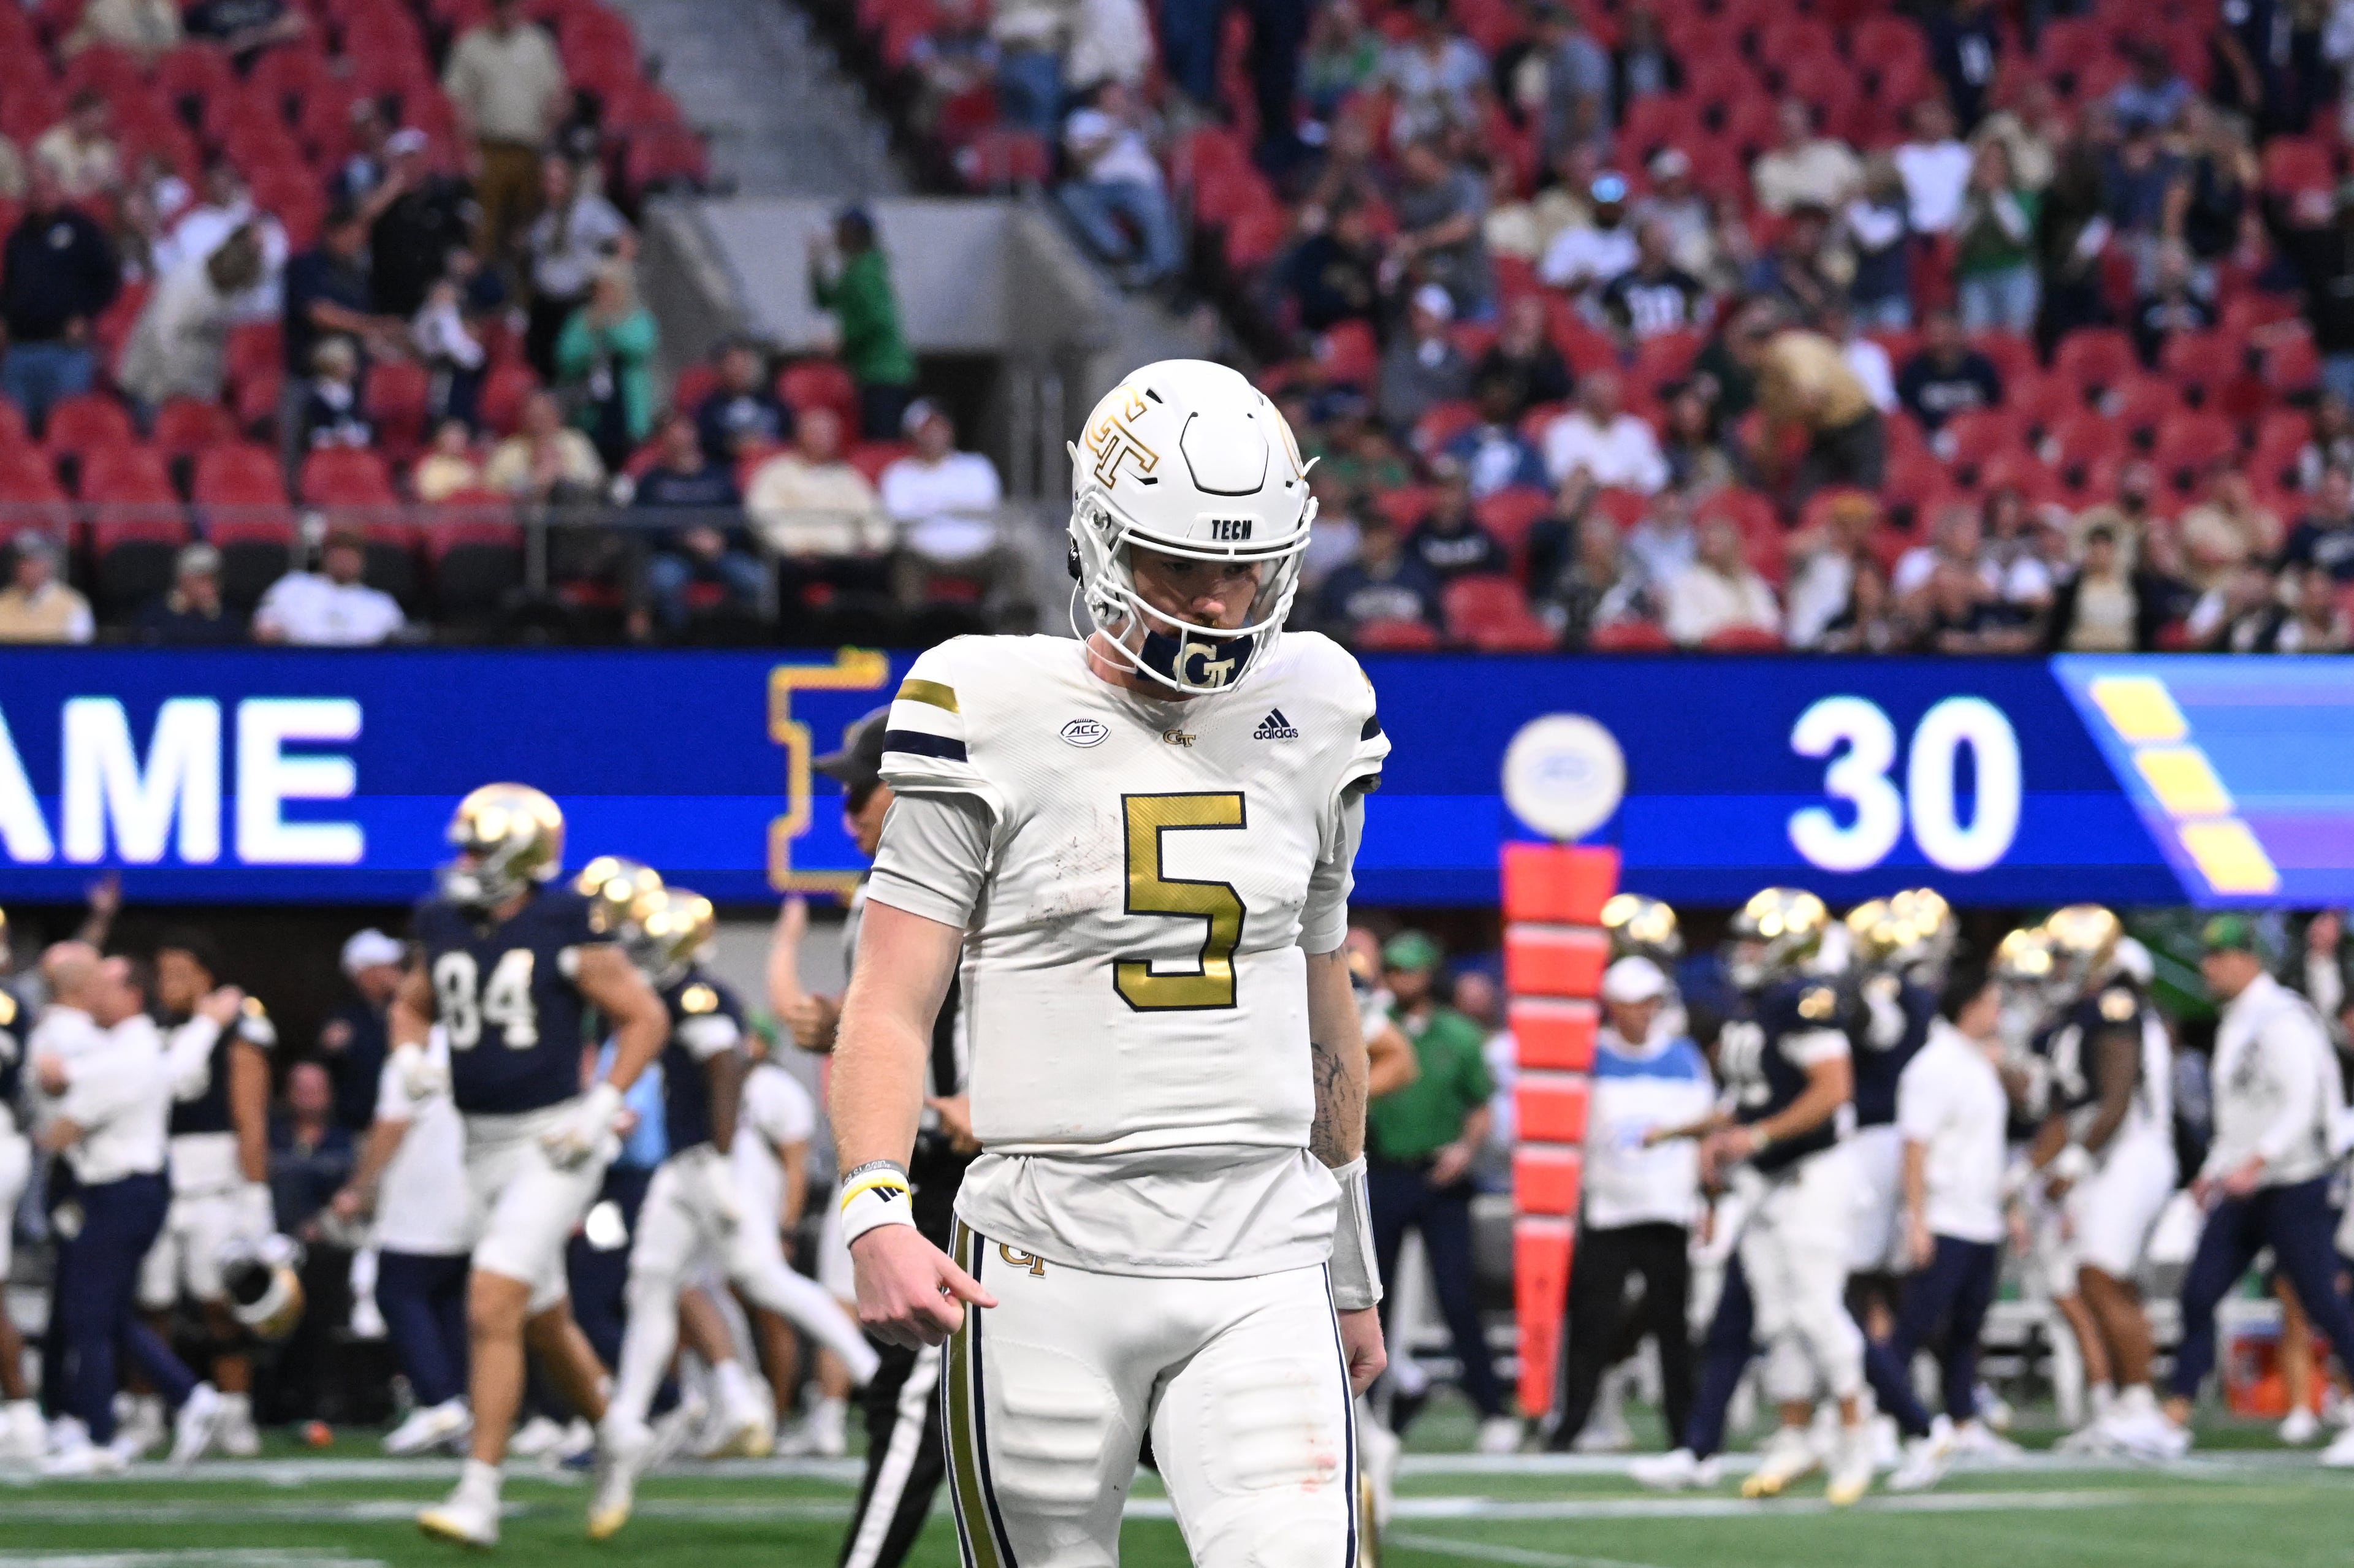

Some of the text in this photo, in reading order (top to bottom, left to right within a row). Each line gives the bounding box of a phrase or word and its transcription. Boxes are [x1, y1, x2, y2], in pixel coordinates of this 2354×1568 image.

[1211, 520, 1252, 539] TECH
[1068, 724, 1100, 735] ACC
[1163, 729, 1196, 748] GT
[1253, 726, 1299, 740] adidas
[1786, 693, 2022, 873] 30
[1113, 791, 1247, 1013] 5
[433, 948, 539, 1050] 84
